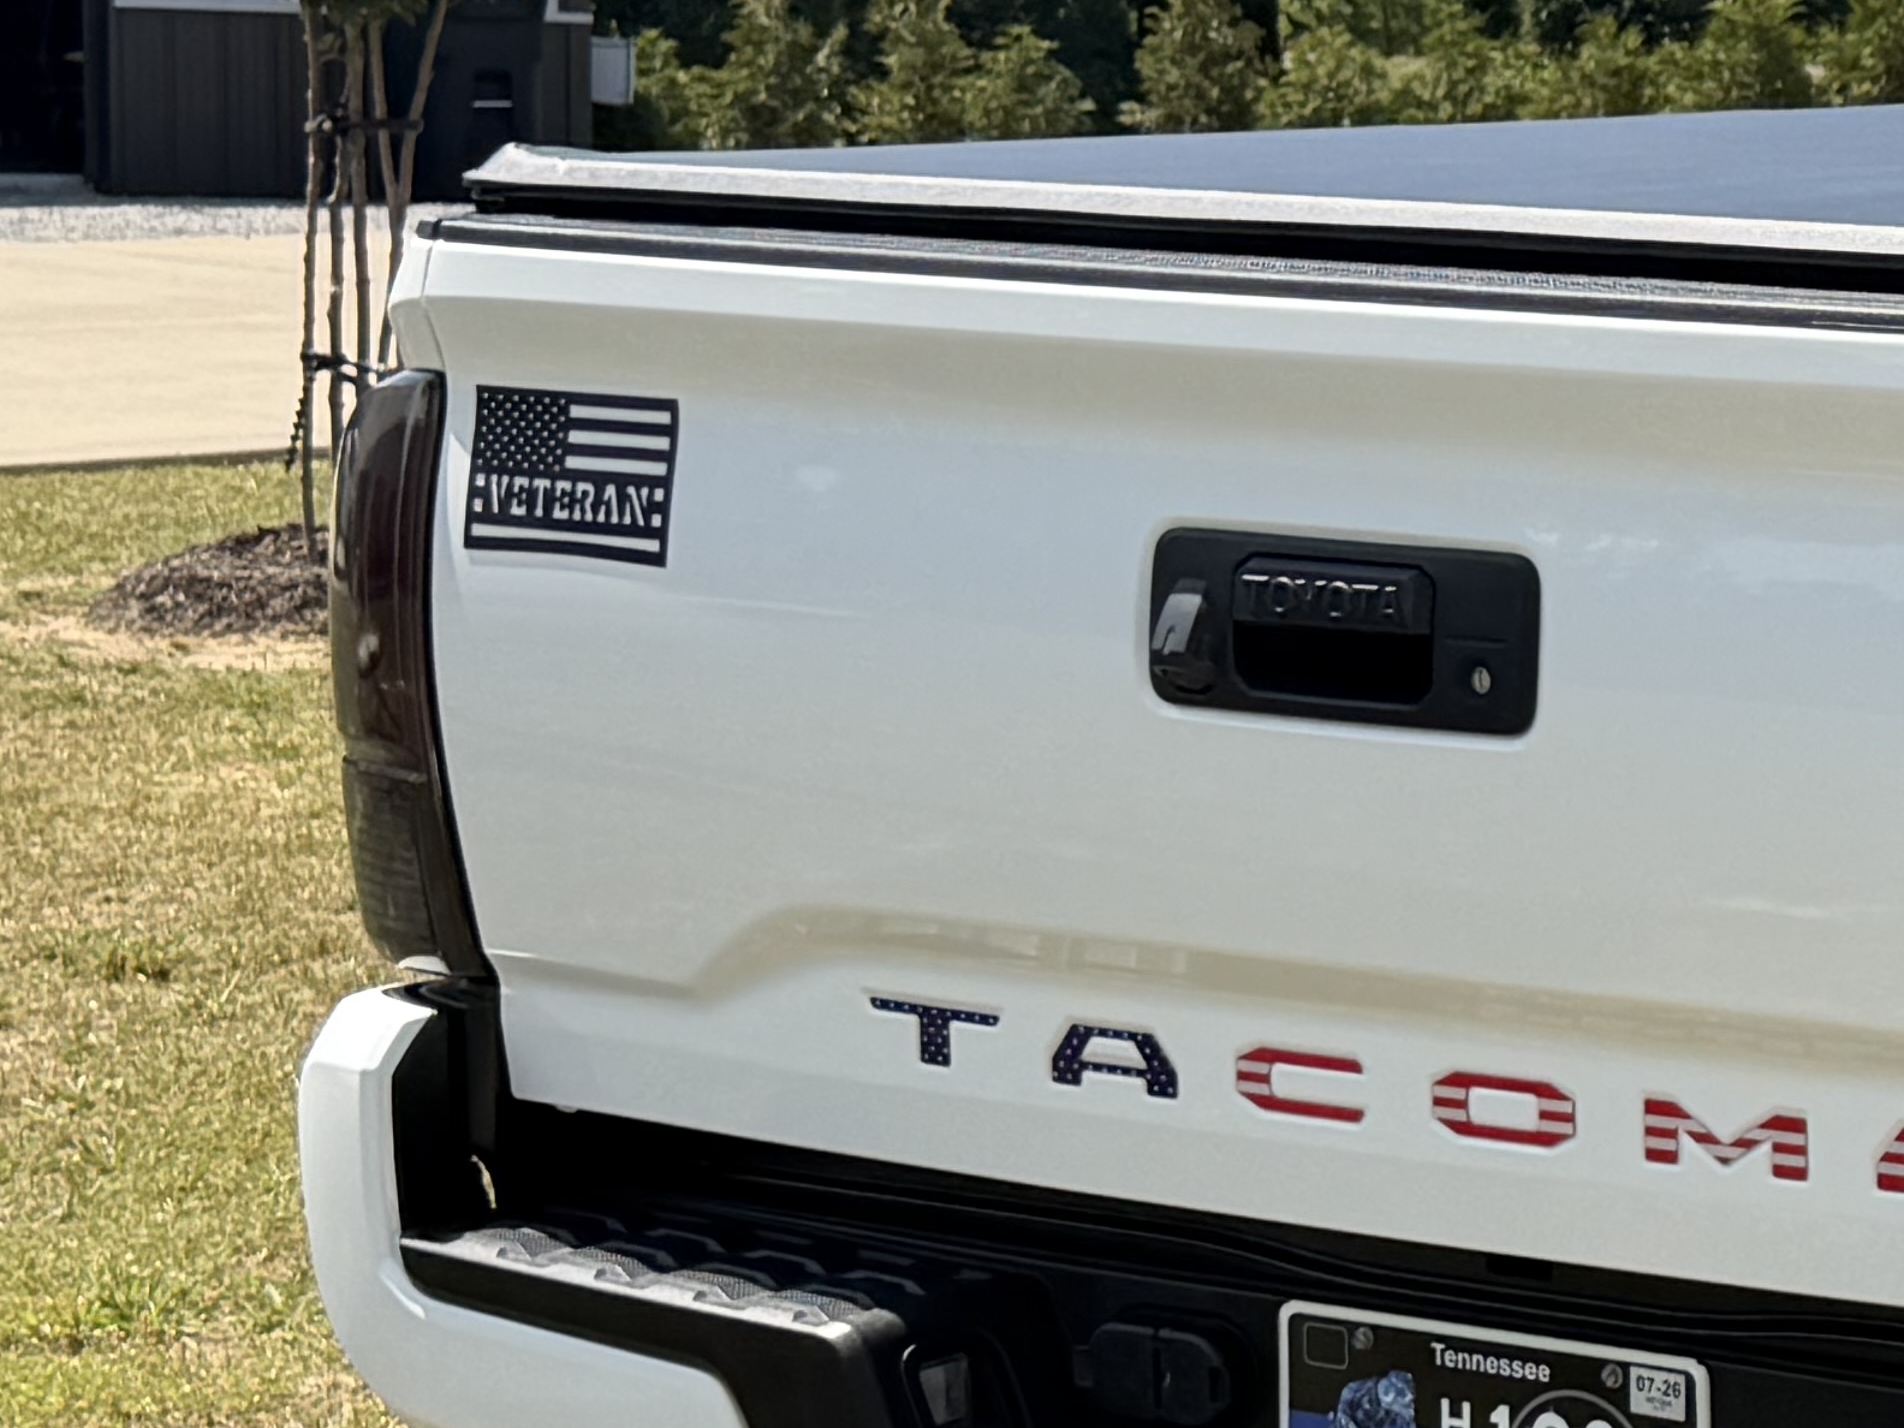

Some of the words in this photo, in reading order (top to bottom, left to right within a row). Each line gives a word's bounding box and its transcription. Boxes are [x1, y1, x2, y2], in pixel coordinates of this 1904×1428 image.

[490, 474, 649, 527] VETERAN
[1241, 573, 1410, 624] TOYOTA
[1430, 1342, 1551, 1383] Tennessee
[1636, 1375, 1682, 1399] 07-26
